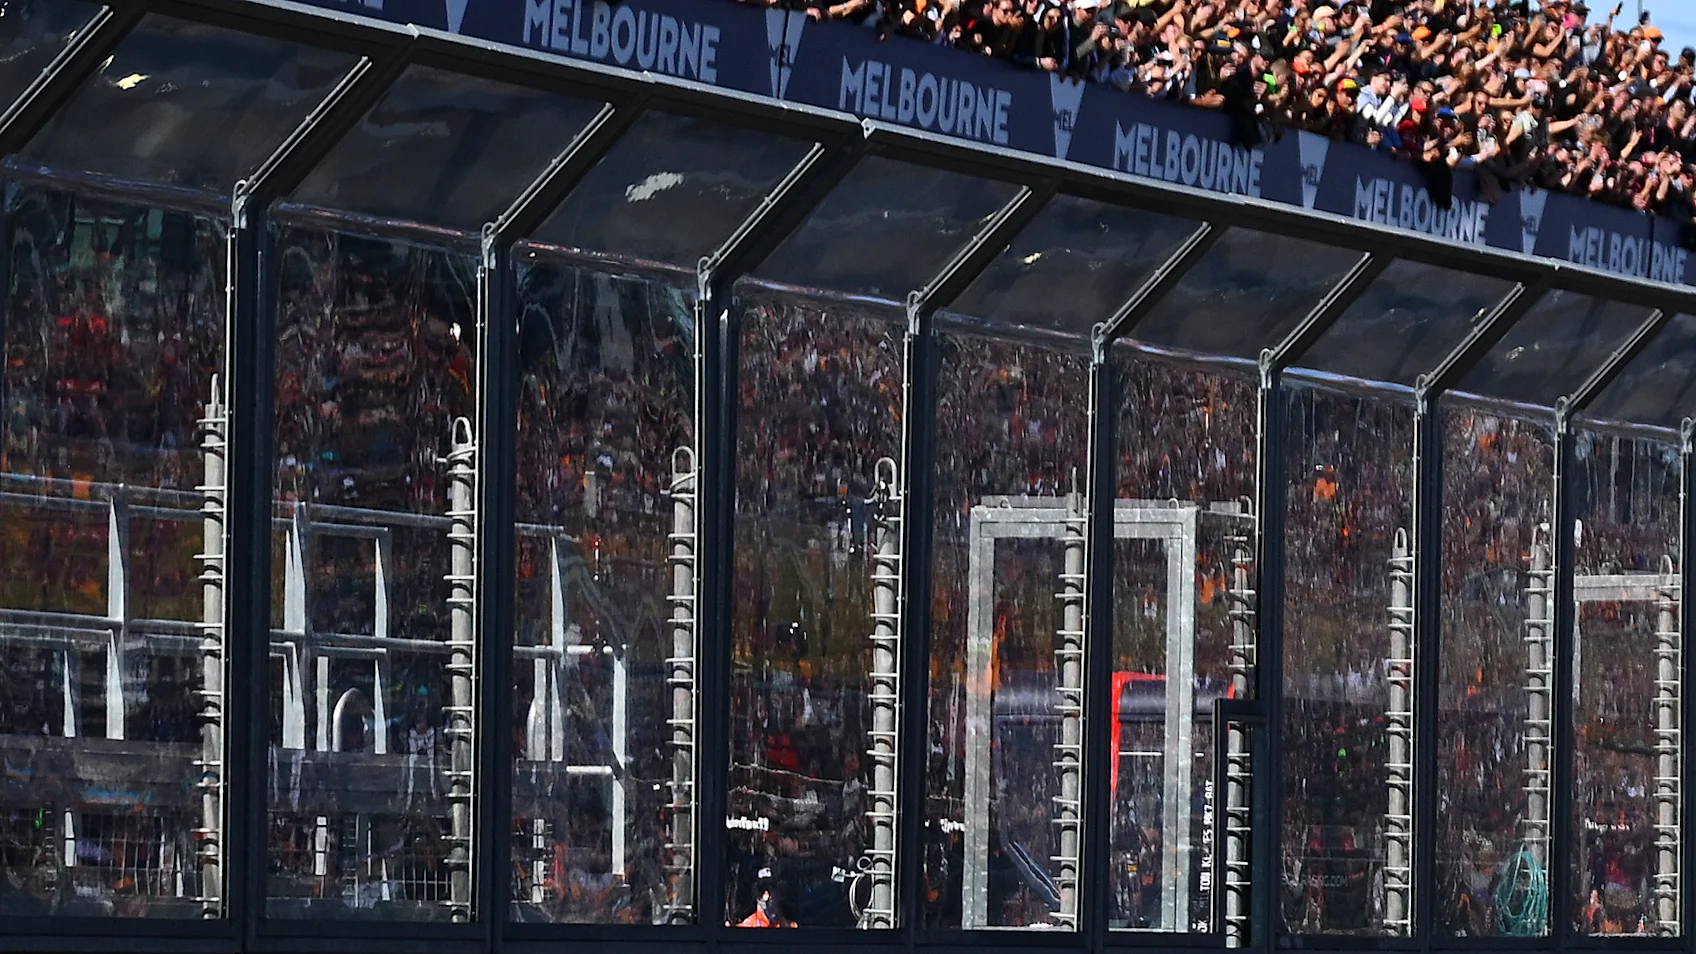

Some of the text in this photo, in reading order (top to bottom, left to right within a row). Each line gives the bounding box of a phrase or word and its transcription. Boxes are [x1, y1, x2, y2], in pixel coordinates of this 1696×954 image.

[522, 0, 720, 84] MELBOURNE
[839, 55, 1012, 145] MELBOURNE
[1112, 119, 1265, 197] MELBOURNE
[1354, 174, 1489, 245] MELBOURNE
[1568, 223, 1690, 285] MELBOURNE
